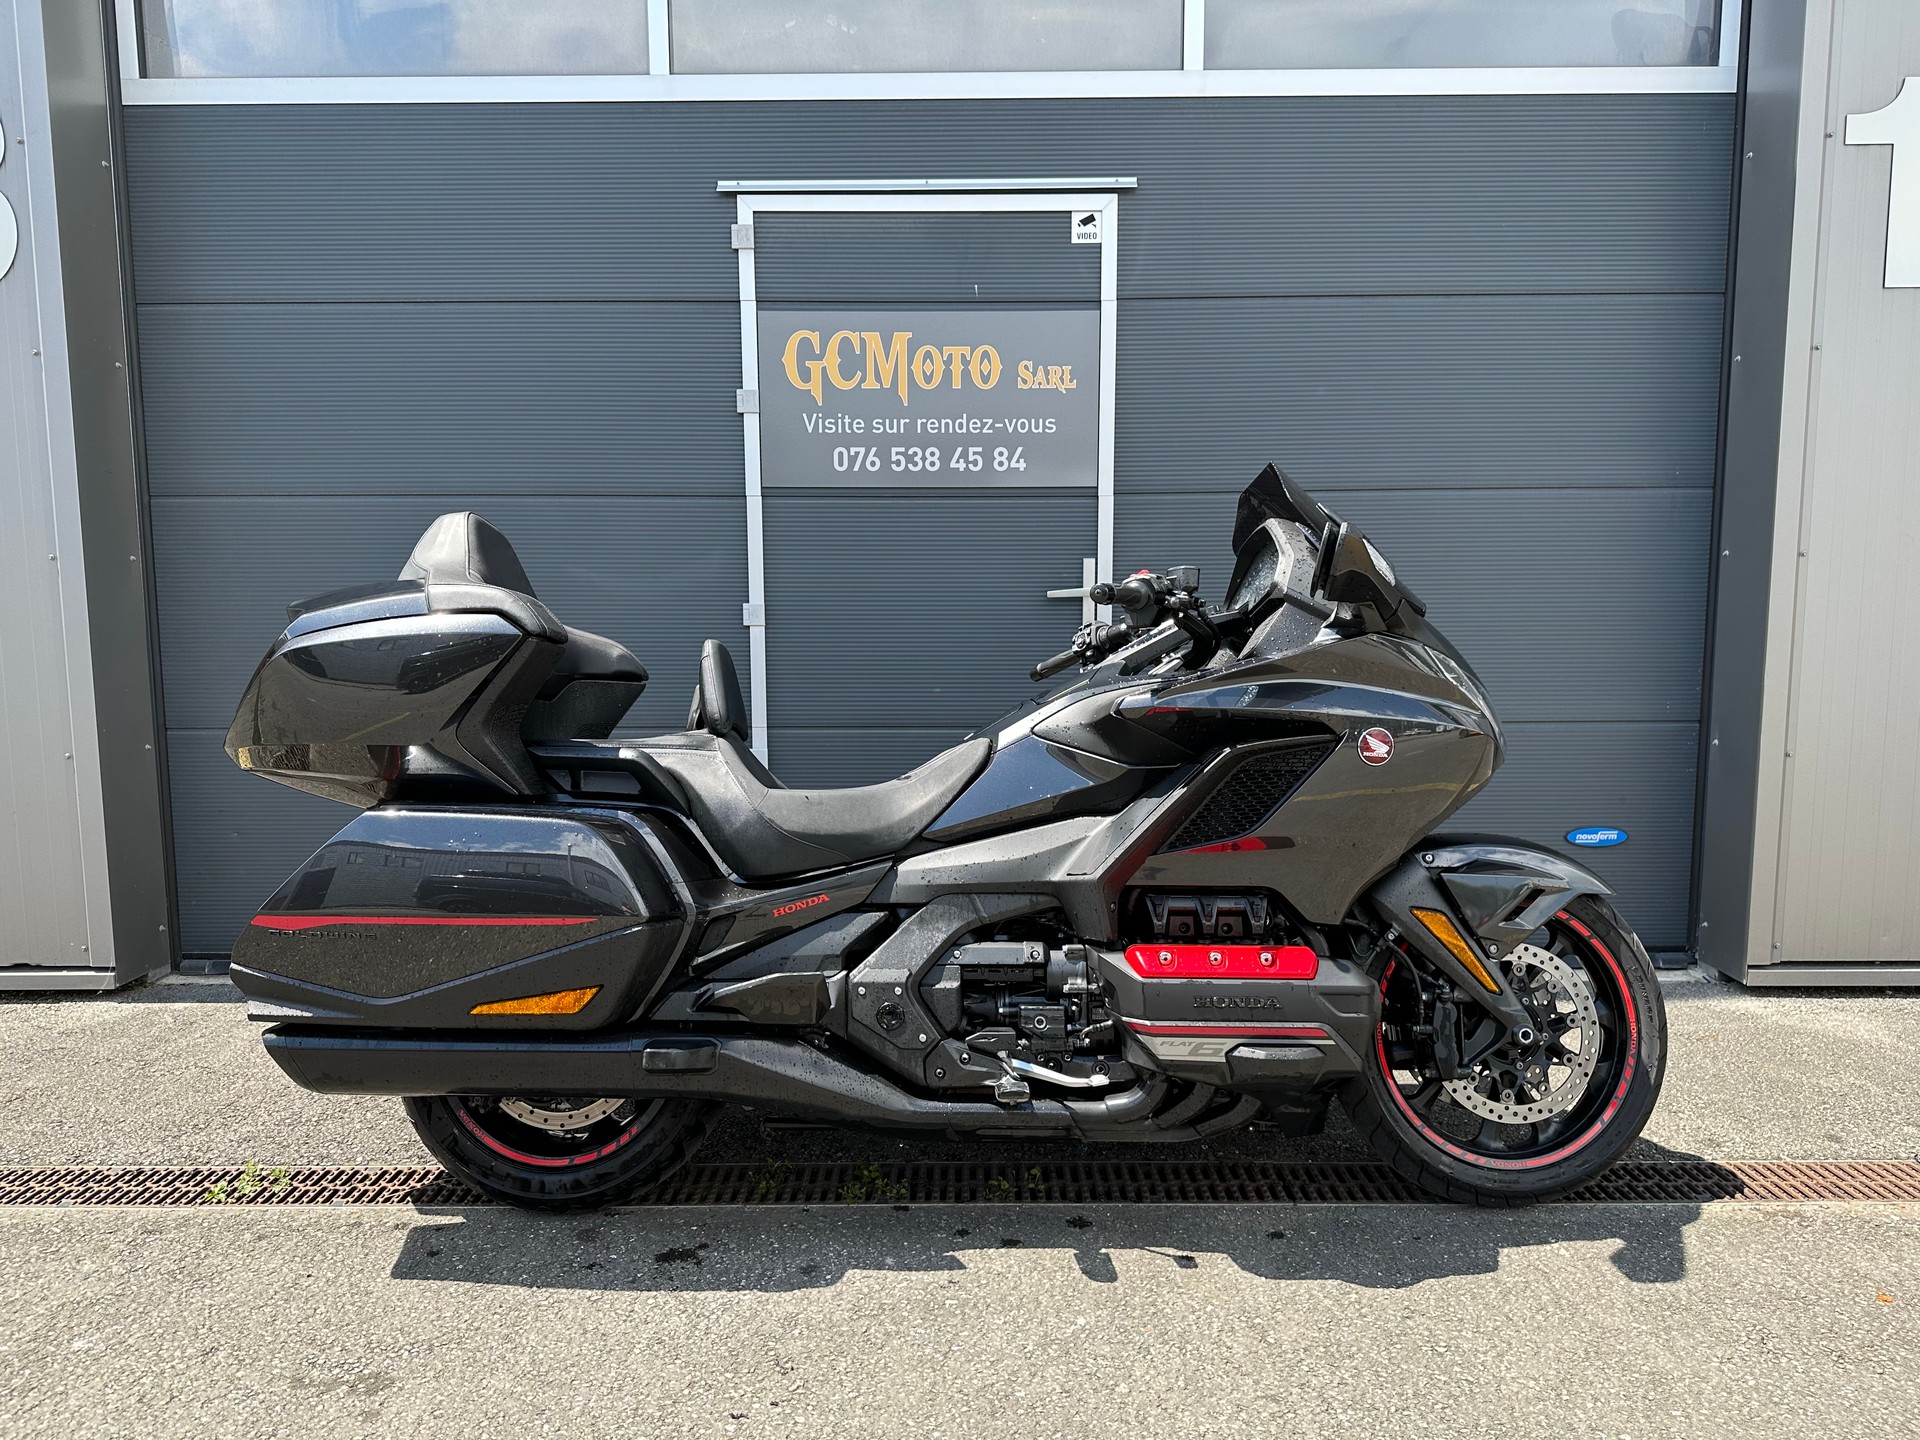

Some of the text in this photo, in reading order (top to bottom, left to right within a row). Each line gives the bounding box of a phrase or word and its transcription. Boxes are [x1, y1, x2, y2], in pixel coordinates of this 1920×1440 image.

[1077, 232, 1097, 240] VIDEO
[802, 413, 1057, 434] Visite sur rendez-vous
[832, 446, 1027, 472] 076 538 45 84
[1575, 830, 1618, 843] novoferm
[772, 893, 830, 918] HONDA
[1193, 995, 1283, 1009] HONDA
[1629, 1018, 1637, 1054] HONDA
[1159, 1040, 1227, 1058] FLAT 6
[459, 1109, 486, 1140] HONDA
[1490, 1159, 1528, 1169] HONDA
